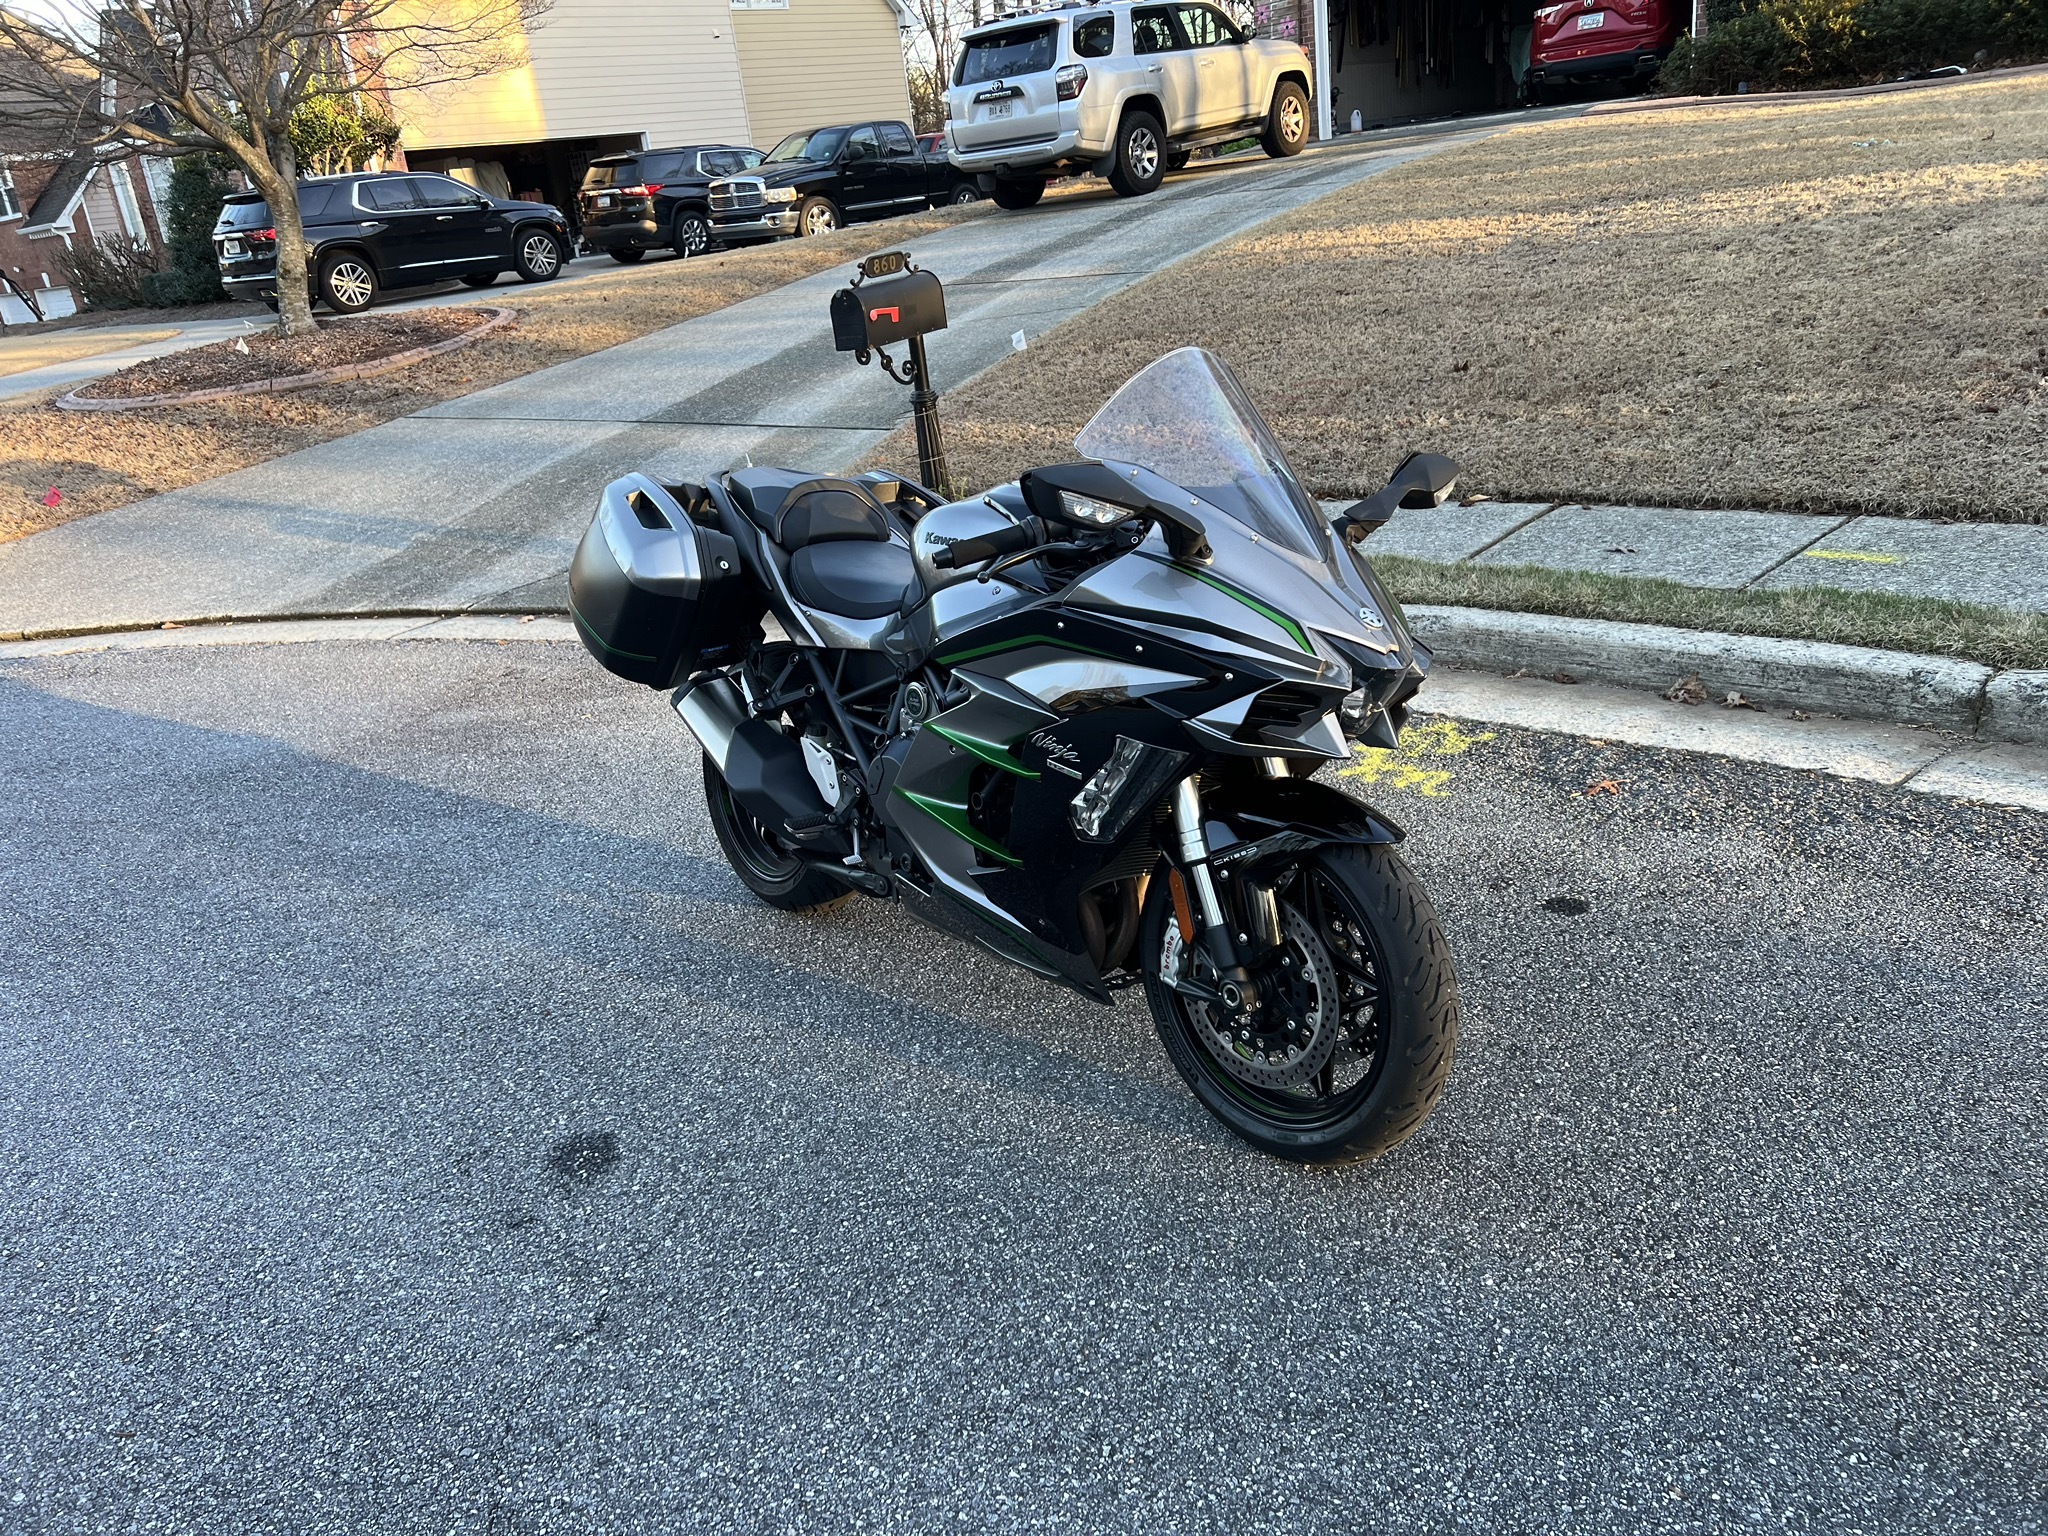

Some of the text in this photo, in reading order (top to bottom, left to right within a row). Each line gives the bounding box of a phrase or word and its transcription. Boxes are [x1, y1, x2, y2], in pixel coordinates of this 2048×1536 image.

[873, 255, 896, 275] 860
[1031, 732, 1081, 762] Ninja
[1163, 935, 1175, 970] brembo
[1165, 1028, 1191, 1069] MICHELIN
